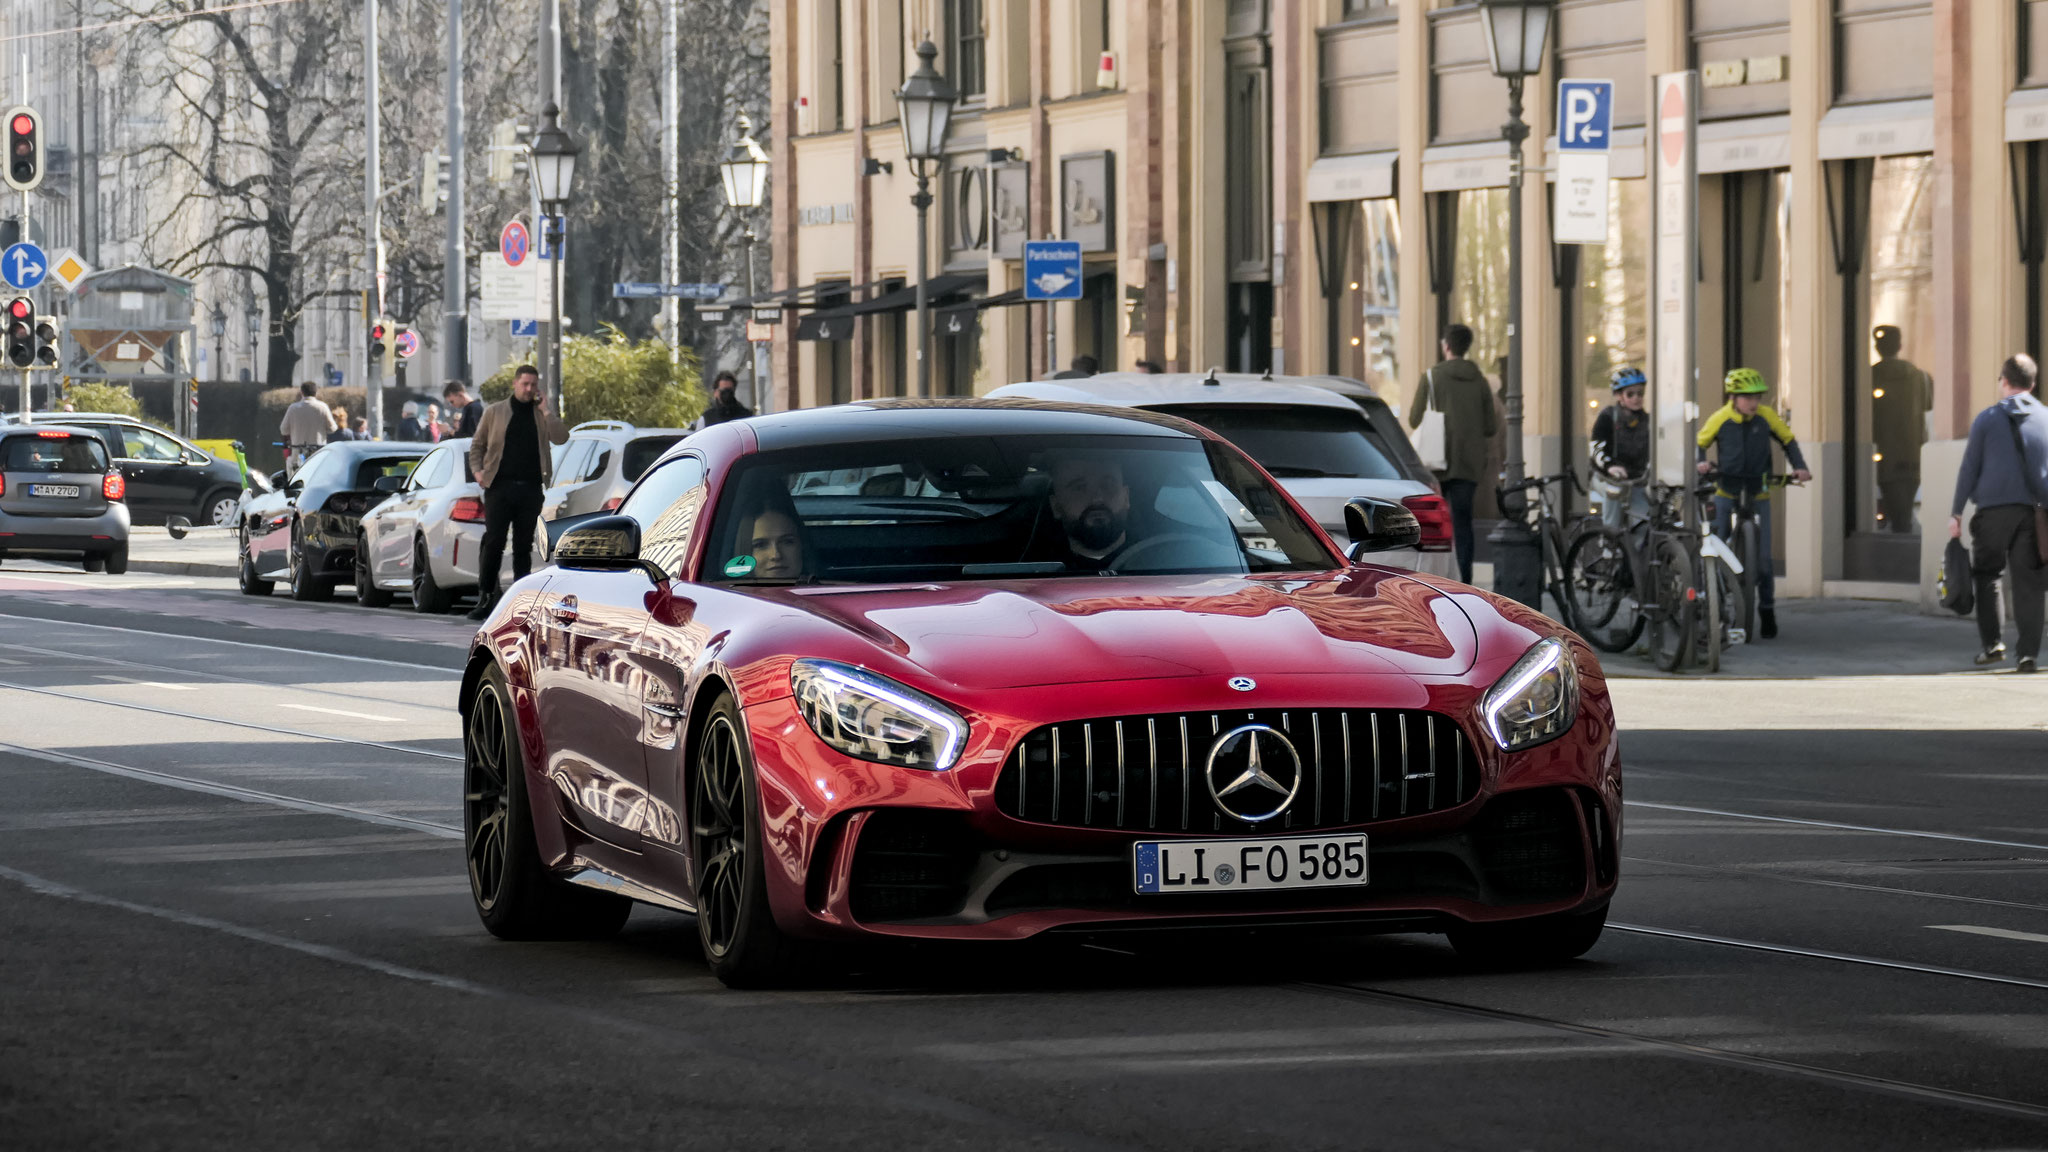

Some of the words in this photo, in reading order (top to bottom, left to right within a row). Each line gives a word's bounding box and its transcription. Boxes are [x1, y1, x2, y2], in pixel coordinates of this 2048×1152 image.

[1565, 88, 1597, 143] P
[1028, 249, 1078, 261] Parkschein
[34, 486, 40, 494] M
[45, 486, 56, 495] AY
[57, 486, 78, 496] 2709
[736, 556, 746, 565] 4
[1162, 848, 1210, 885] LI
[1240, 845, 1288, 884] FO
[1299, 841, 1364, 881] 585
[1143, 873, 1153, 885] D
